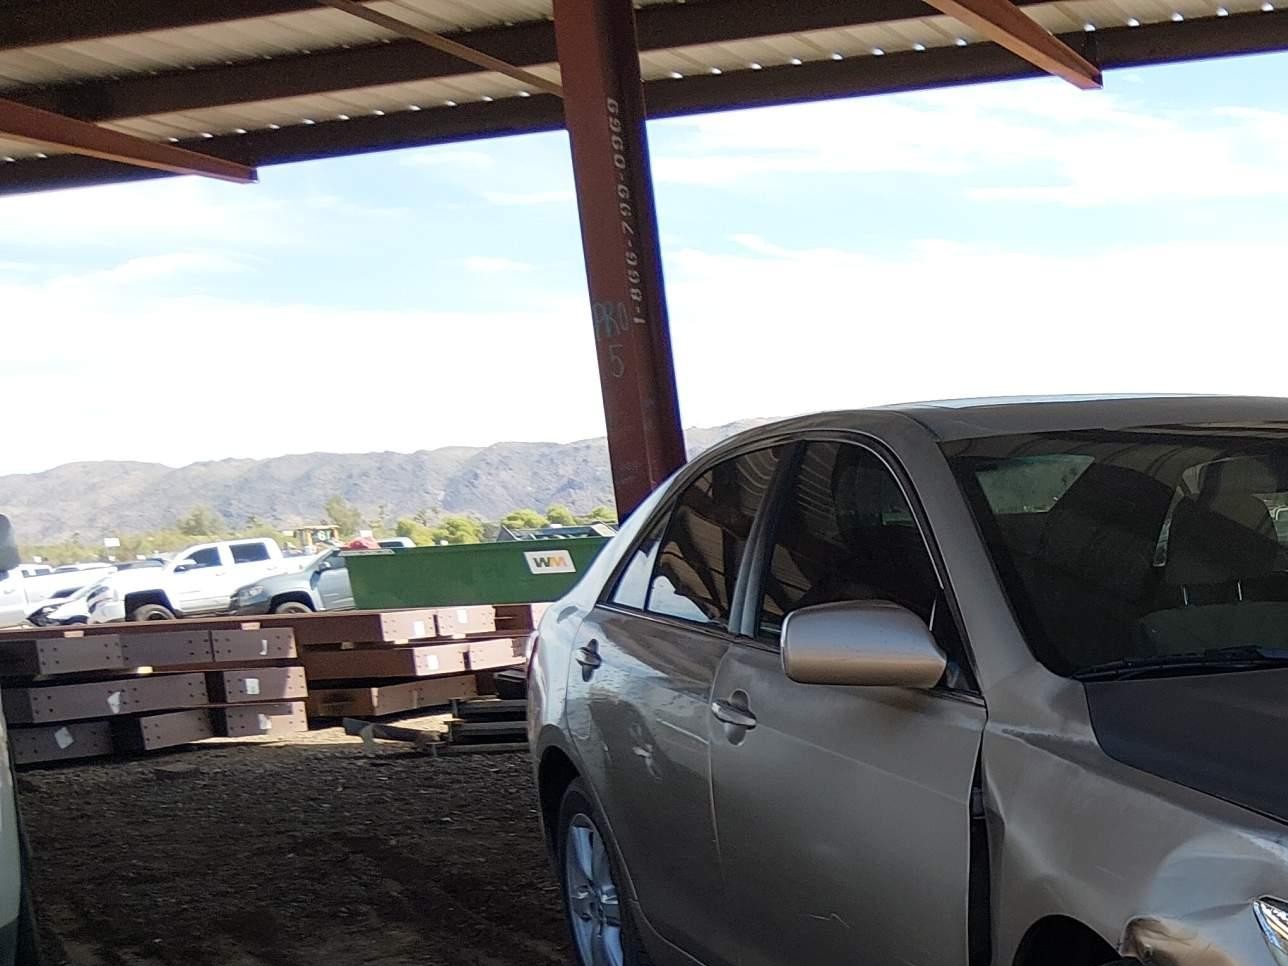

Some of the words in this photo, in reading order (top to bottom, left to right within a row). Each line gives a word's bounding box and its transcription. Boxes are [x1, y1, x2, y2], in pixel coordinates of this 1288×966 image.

[607, 97, 646, 323] 1-866-799-0969
[608, 343, 625, 378] 5
[532, 556, 569, 568] WM
